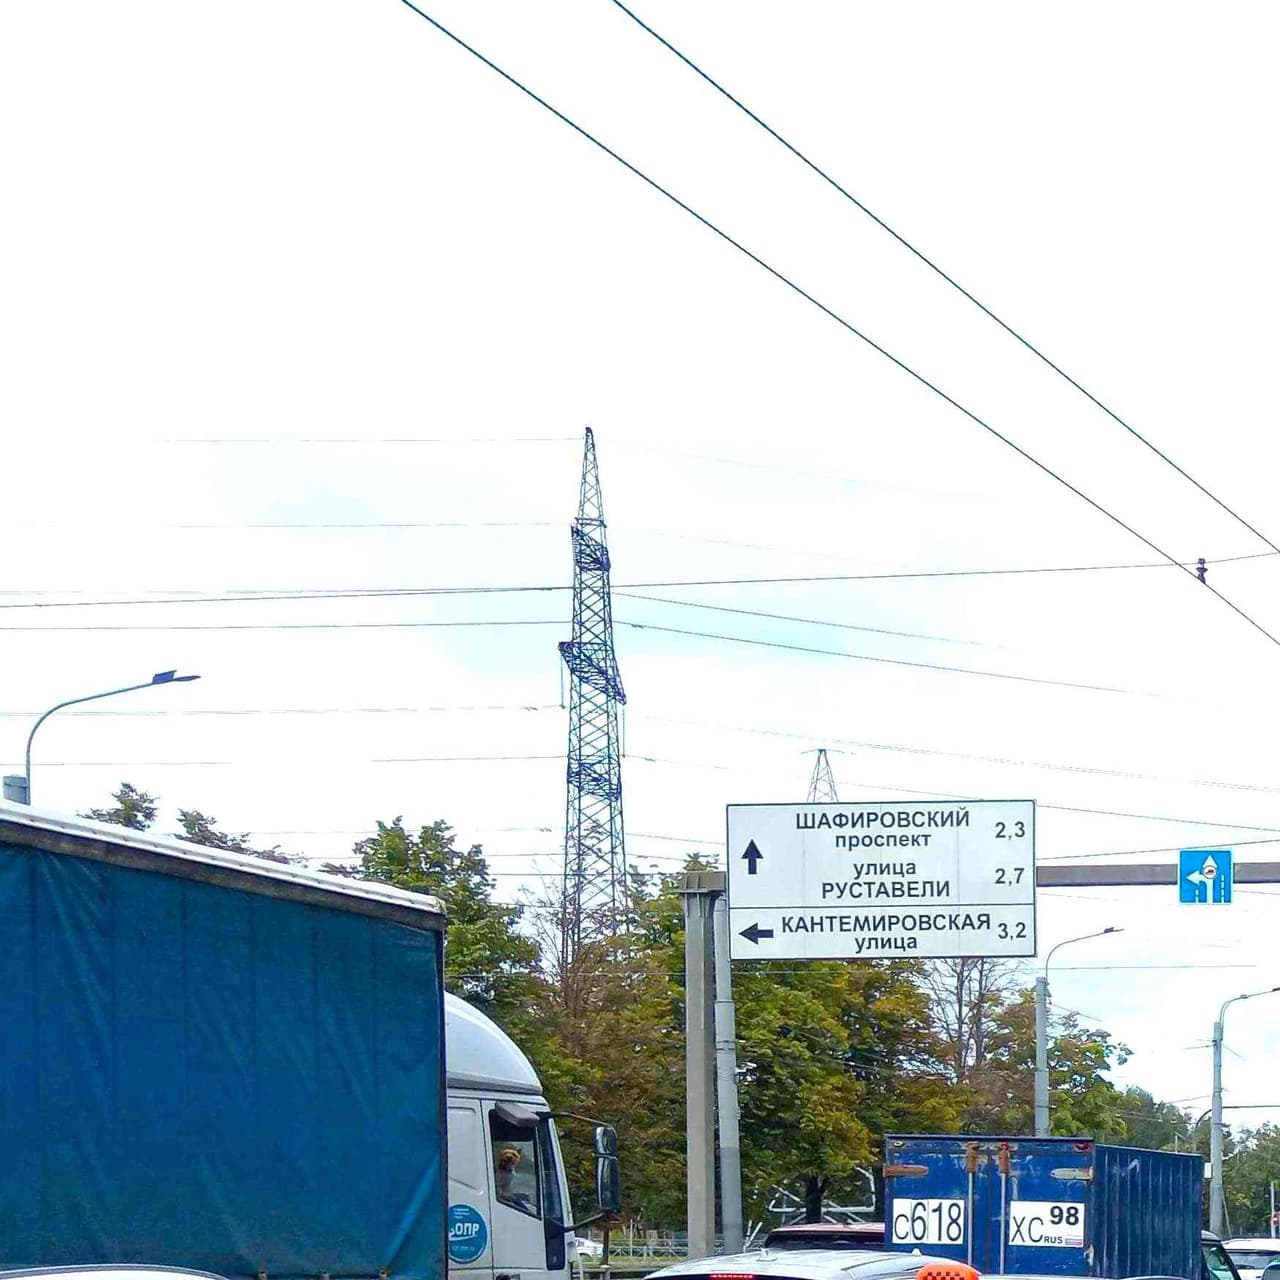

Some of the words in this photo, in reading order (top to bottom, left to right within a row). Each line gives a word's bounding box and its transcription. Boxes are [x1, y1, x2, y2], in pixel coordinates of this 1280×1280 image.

[795, 806, 970, 830] ШАФИРОВСКИЙ
[994, 821, 1026, 840] 2,3
[835, 834, 932, 851] проспект
[853, 862, 916, 880] улица
[994, 868, 1025, 885] 2,7
[821, 880, 950, 899] РУСТАВЕЛИ
[782, 914, 991, 934] КАНТЕМИРОВСКАЯ
[997, 923, 1027, 940] 3,2
[855, 935, 918, 953] улица
[1050, 1205, 1080, 1226] 98
